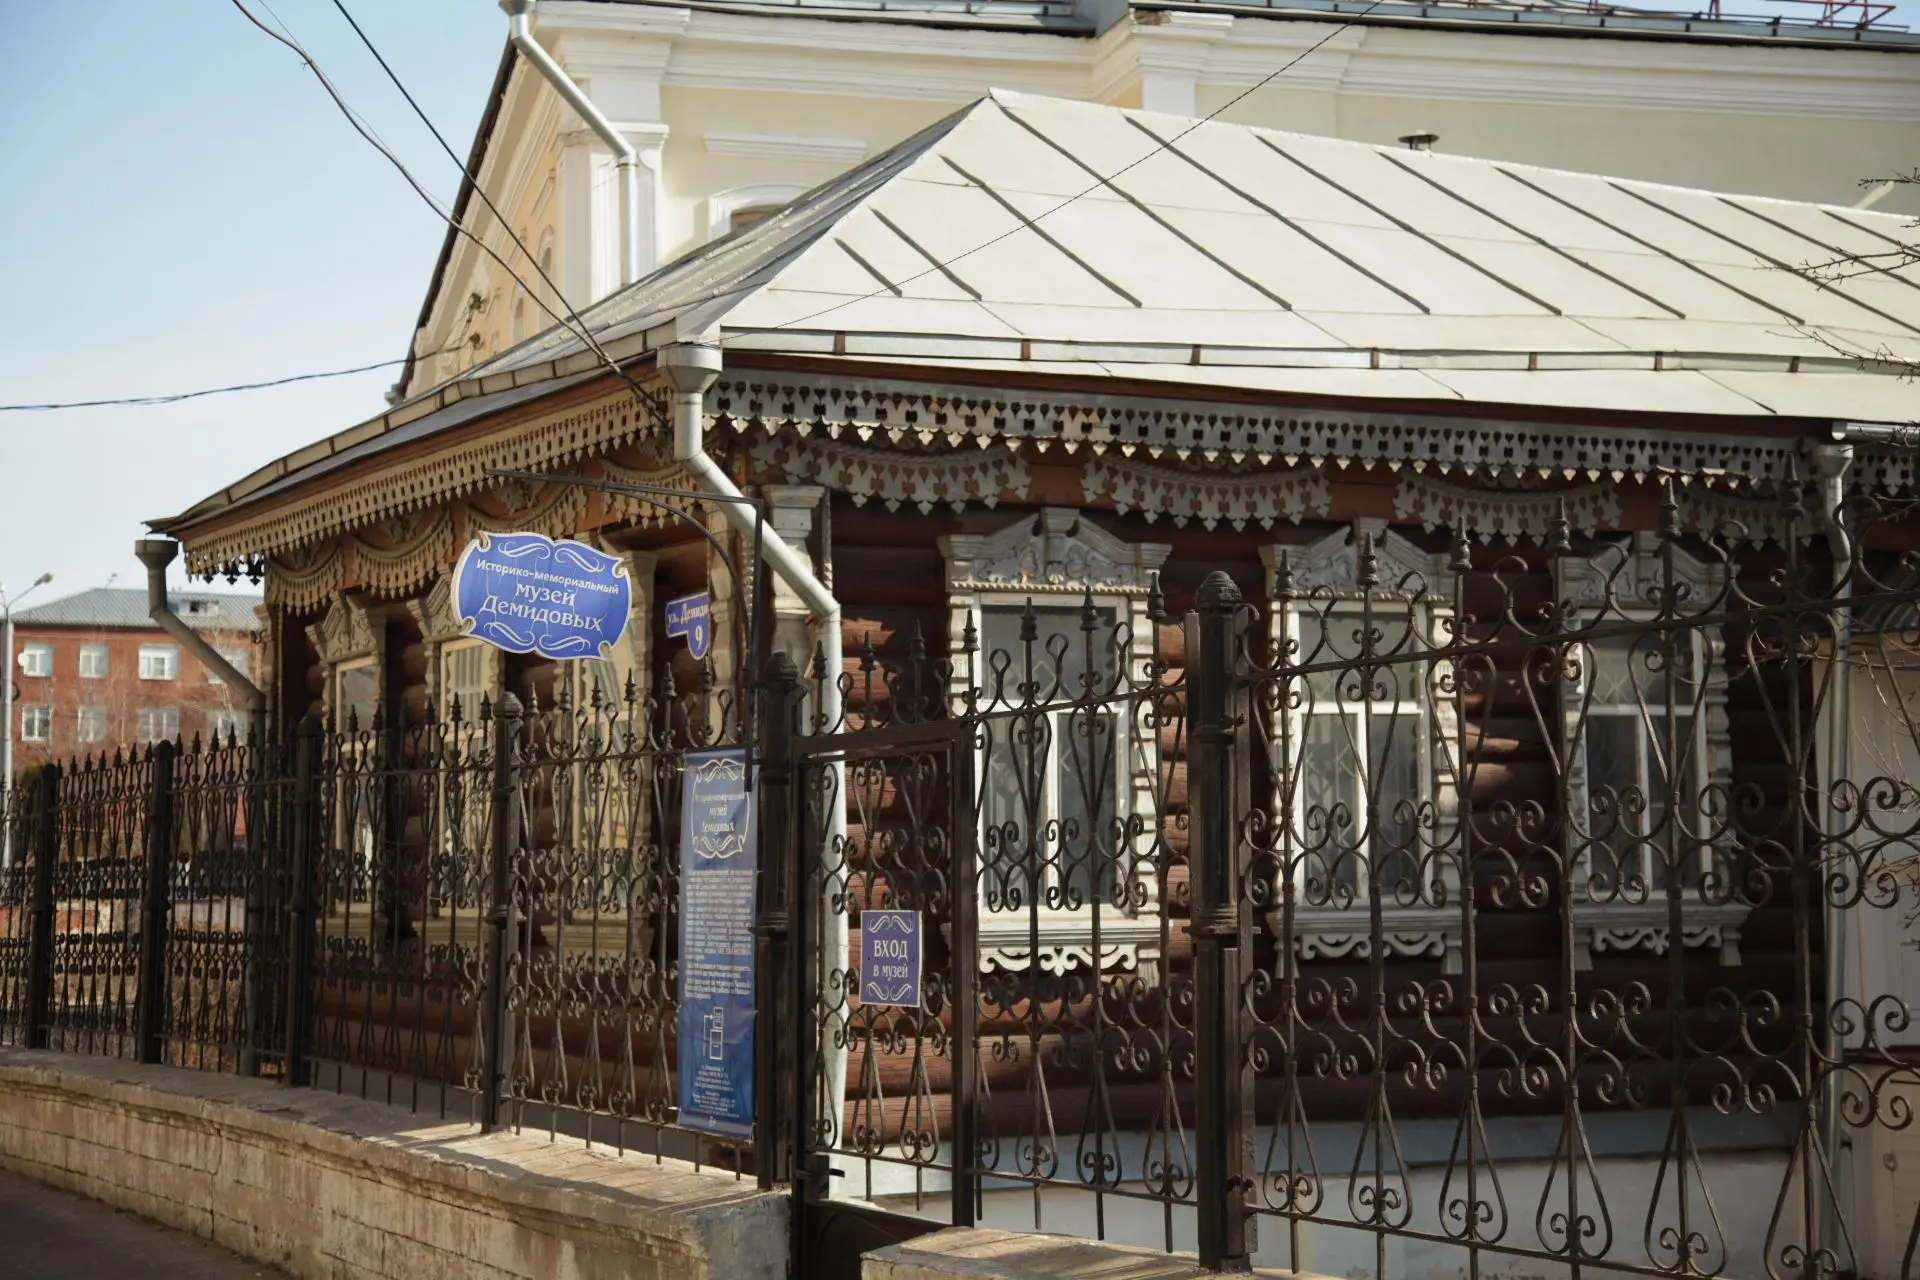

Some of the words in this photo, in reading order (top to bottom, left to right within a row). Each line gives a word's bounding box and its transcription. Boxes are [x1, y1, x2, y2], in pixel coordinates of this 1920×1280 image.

[476, 558, 619, 595] Историко-мемориальный
[515, 583, 576, 607] музей
[478, 595, 603, 633] Демидовых
[695, 625, 703, 650] 9
[873, 939, 909, 962] ВХОД
[873, 964, 880, 977] в
[881, 962, 908, 982] музей
